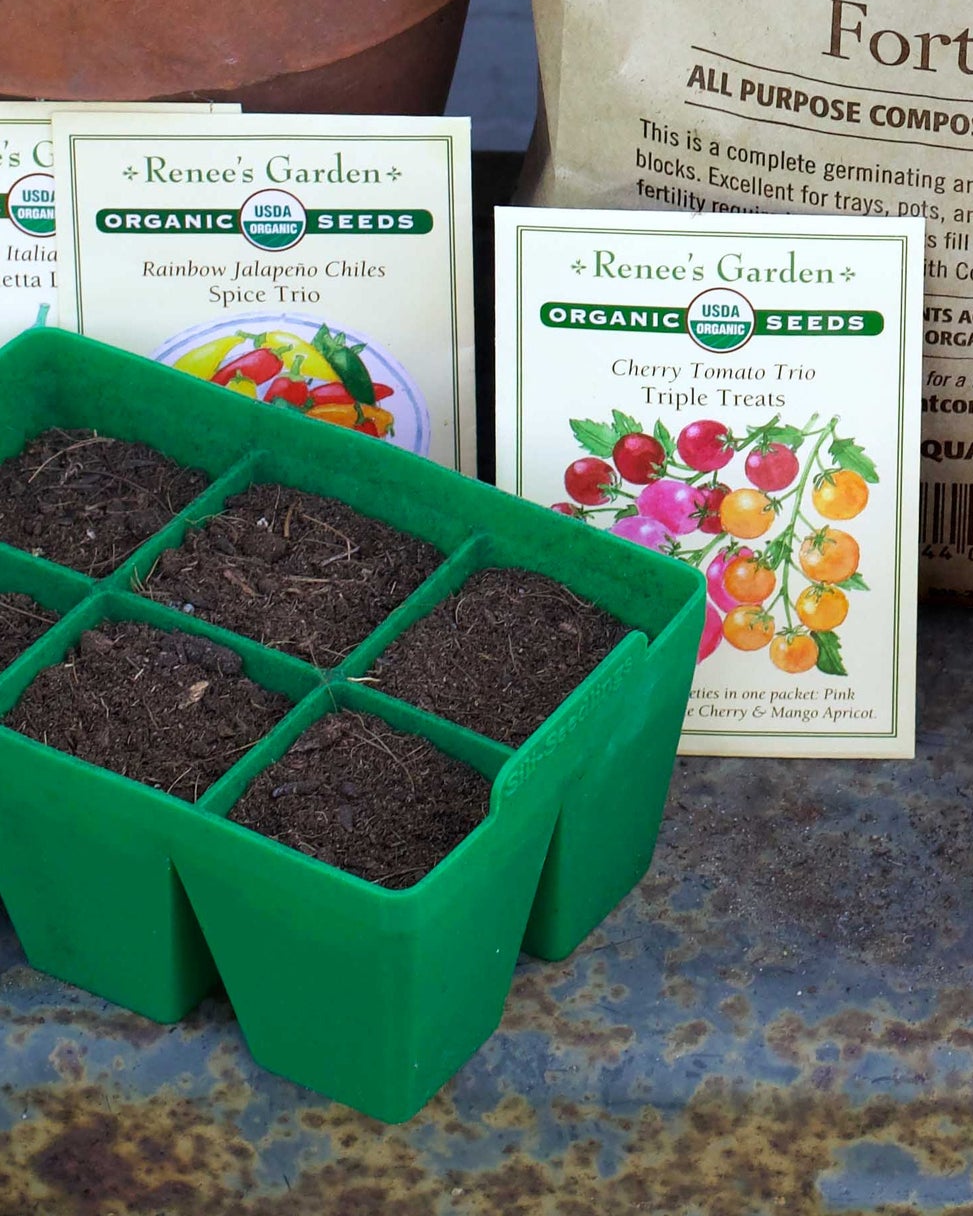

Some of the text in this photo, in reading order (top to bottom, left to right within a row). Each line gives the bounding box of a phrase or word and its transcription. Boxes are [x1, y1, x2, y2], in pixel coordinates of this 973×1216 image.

[686, 64, 732, 96] ALL
[740, 78, 861, 123] PURPOSE
[640, 117, 679, 147] This
[686, 130, 702, 152] is
[709, 140, 720, 157] a
[727, 143, 816, 175] complete
[823, 162, 946, 194] germinating
[143, 152, 380, 184] Renee's Garden
[636, 149, 701, 182] blocks.
[709, 167, 795, 203] Excellent
[801, 185, 829, 207] for
[834, 190, 890, 217] trays,
[898, 201, 945, 223] pots,
[636, 179, 706, 212] fertility
[17, 207, 55, 219] ORGAN
[254, 204, 292, 218] USDA
[104, 213, 415, 229] ORGANIC SEEDS
[249, 222, 298, 235] ORGANIC
[944, 232, 969, 251] fill
[7, 244, 58, 262] Italia
[142, 260, 386, 282] Rainbow Jalapeño Chiles
[593, 250, 834, 284] Renee's Garden
[924, 259, 947, 278] ith
[2, 271, 42, 288] etta
[208, 285, 321, 308] Spice Trio
[549, 308, 864, 331] ORGANIC SEEDS
[702, 304, 740, 319] USDA
[696, 322, 745, 336] ORGANIC
[612, 358, 816, 383] Cherry Tomato Trio
[926, 371, 951, 387] for
[955, 375, 966, 387] a
[642, 386, 786, 411] Triple Treats
[689, 687, 855, 703] eties in one packet: Pink
[698, 705, 748, 721] Cherry
[752, 707, 767, 718] &
[771, 707, 819, 722] Mango
[823, 706, 877, 722] Apricot.
